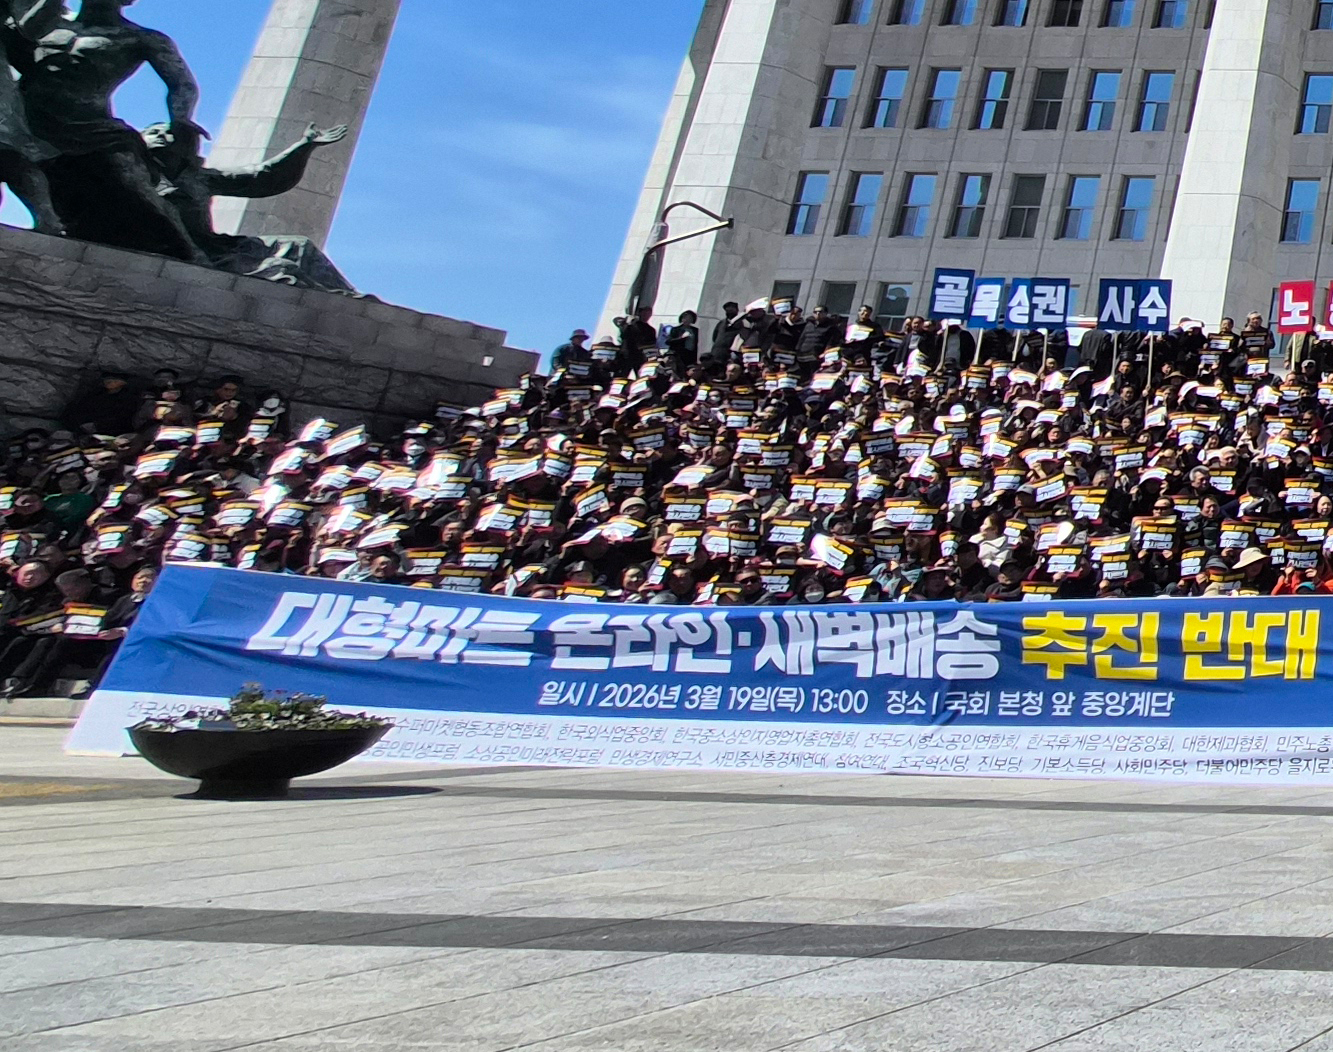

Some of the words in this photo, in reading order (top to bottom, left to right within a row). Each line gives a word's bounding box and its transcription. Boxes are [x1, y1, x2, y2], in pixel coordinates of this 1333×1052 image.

[933, 274, 1067, 325] 골목상권
[1099, 285, 1168, 326] 사수
[1020, 610, 1161, 681] 추진
[1180, 608, 1321, 681] 반대
[538, 680, 587, 707] 일시
[598, 682, 682, 711] 2026년
[683, 685, 722, 711] 3월
[727, 686, 804, 715] 19일(목)
[810, 687, 870, 715] 13:00
[886, 690, 927, 716] 장소
[944, 691, 991, 716] 국회
[997, 691, 1044, 717] 본청
[1050, 691, 1076, 717] 앞
[1080, 691, 1176, 718] 중앙계단
[1276, 735, 1333, 754] 민주노총
[1195, 758, 1282, 777] 더불어민주당
